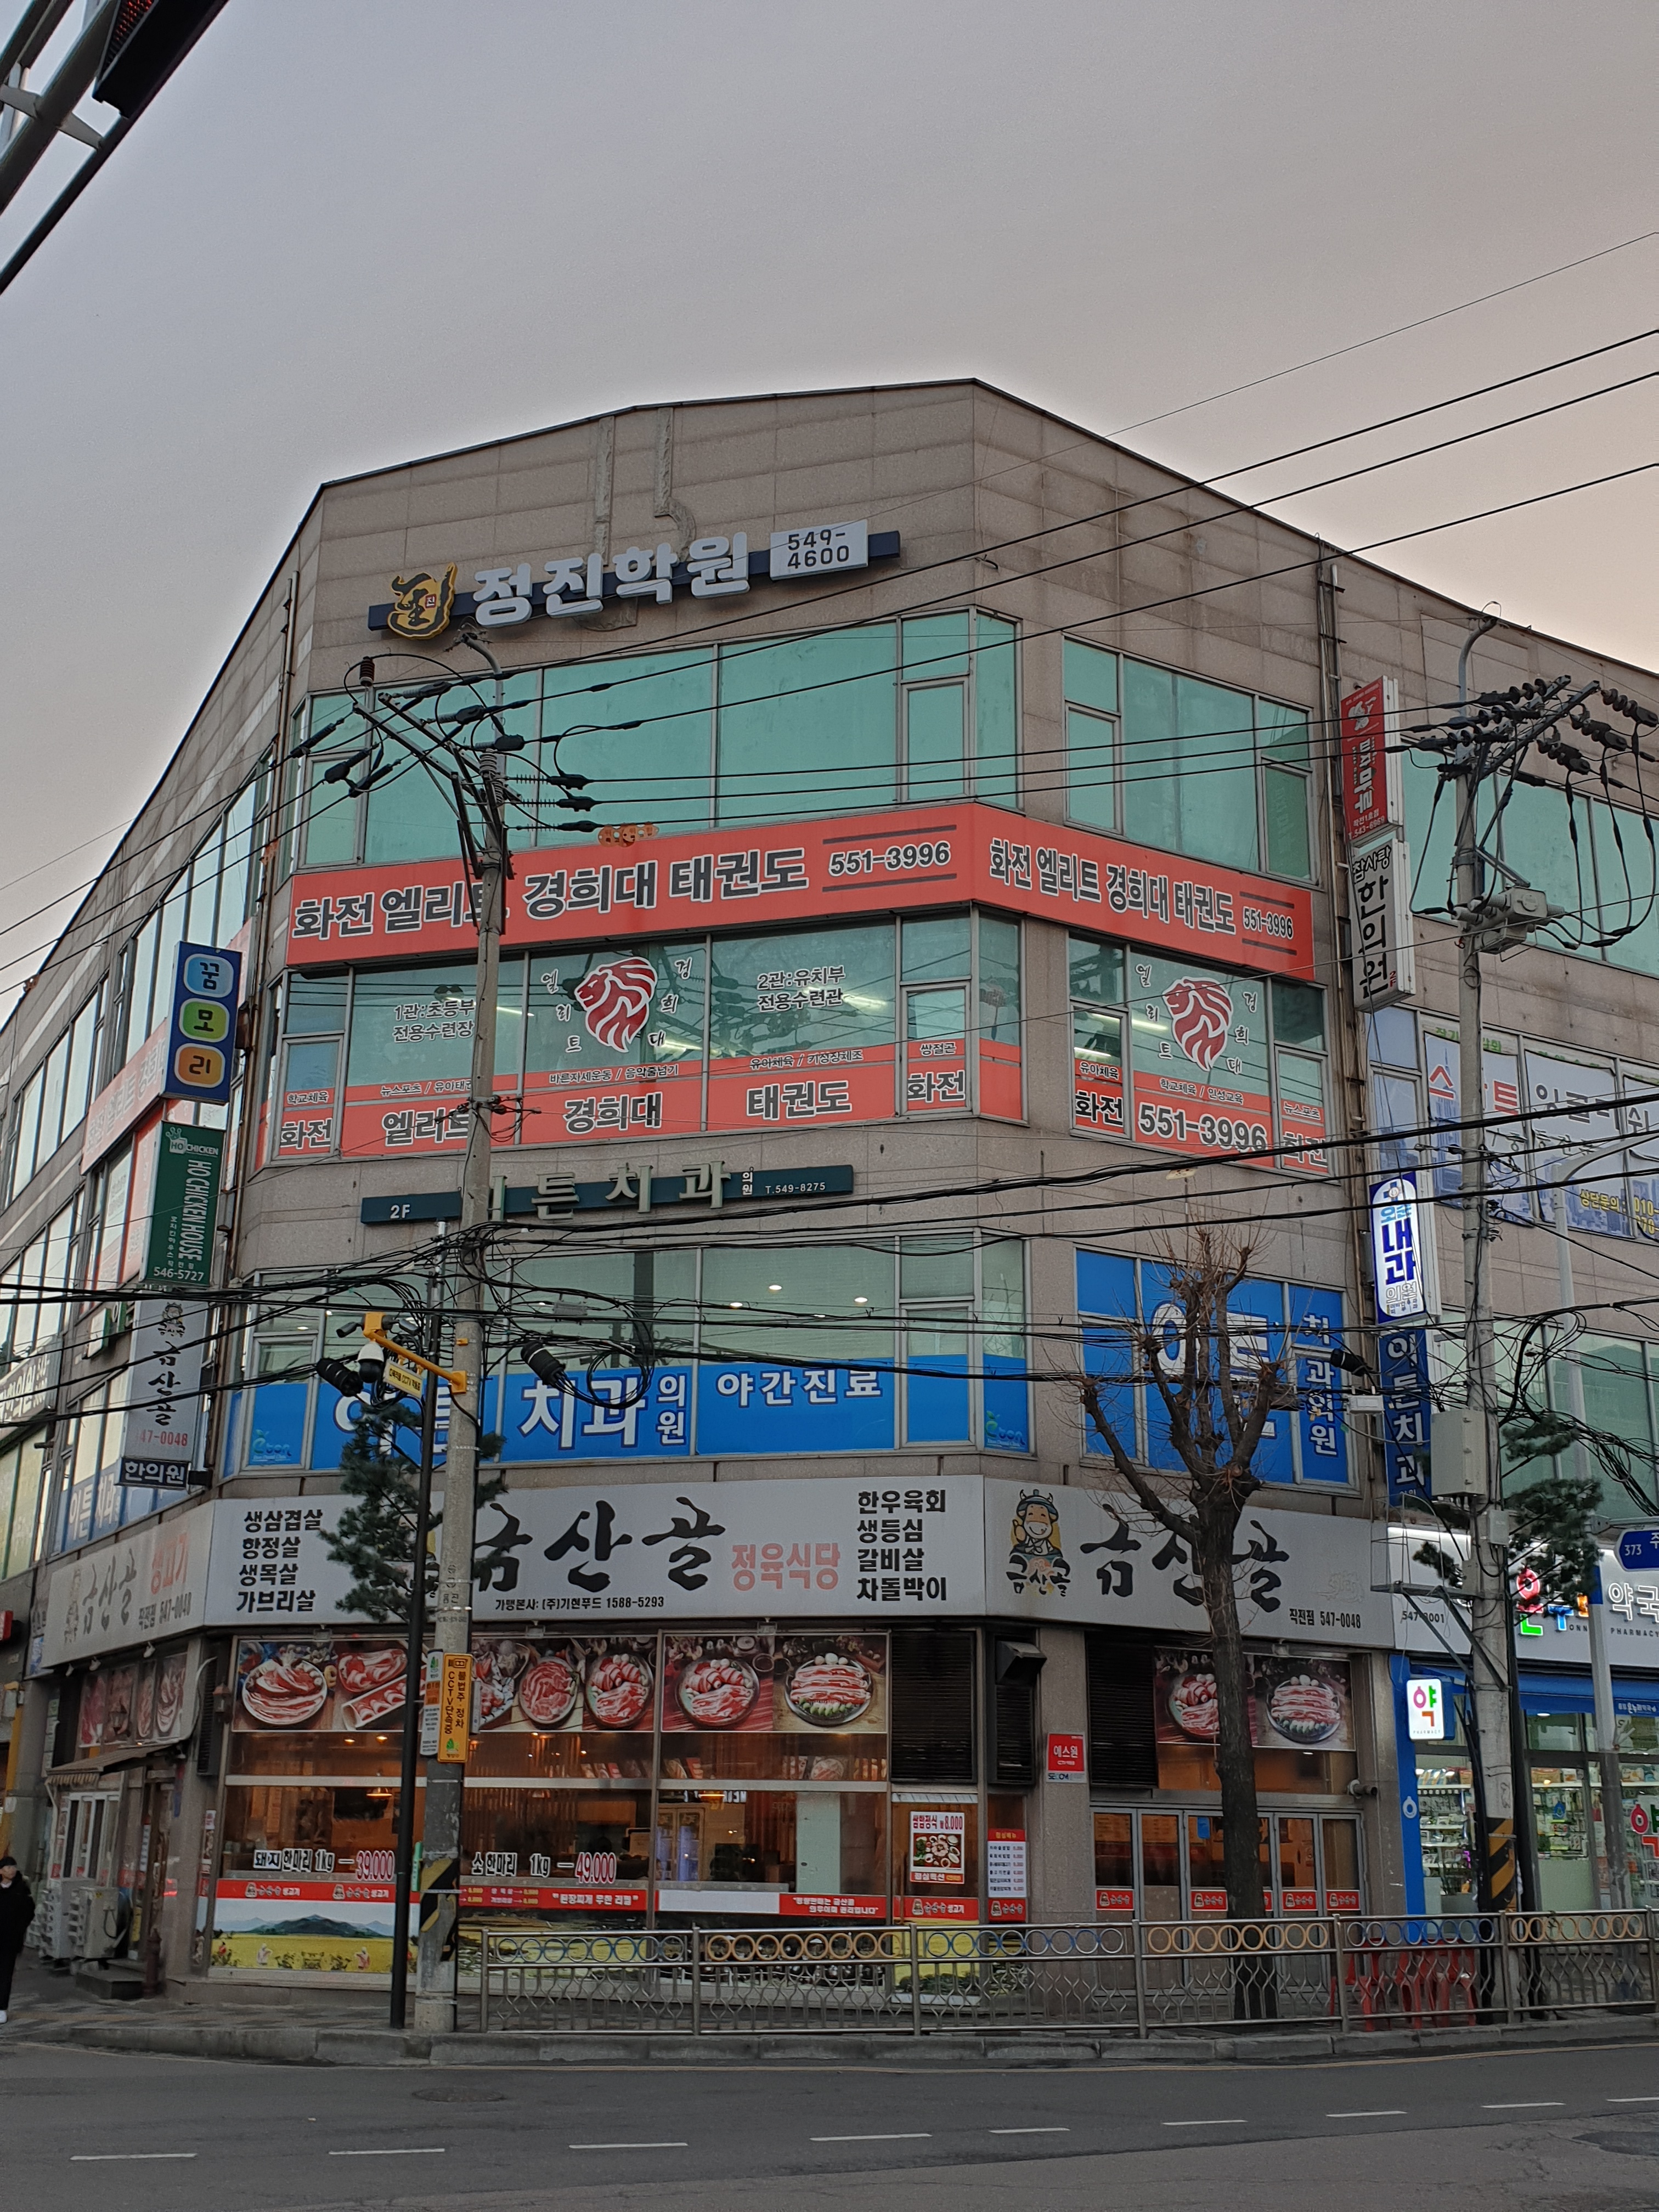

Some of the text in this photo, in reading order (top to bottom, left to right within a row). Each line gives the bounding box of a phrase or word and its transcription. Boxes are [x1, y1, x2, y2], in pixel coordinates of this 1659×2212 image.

[787, 529, 845, 551] 549-
[787, 544, 850, 569] 4600
[473, 531, 751, 628] 정진학원
[292, 891, 374, 940] 화전
[523, 860, 658, 921] 경희대
[669, 848, 809, 903] 태권도
[829, 840, 950, 877] 551-3996
[990, 837, 1294, 940] 화전 엘리트 경희대 태권도 551-3996
[1358, 875, 1389, 999] 한의원
[758, 988, 843, 1012] 전용수련관
[393, 1020, 475, 1042] 전용수련장
[920, 1042, 957, 1057] 쌍절곤
[550, 1064, 679, 1085] 바른자세운동 음악줄넘기
[749, 1056, 794, 1071] 유아체육
[1079, 1061, 1119, 1080] 유아체육
[287, 1091, 328, 1105] 학교체육
[380, 1082, 422, 1096] 뉴스포츠
[1160, 1078, 1244, 1105] 학교체육 인성교육
[1429, 1065, 1519, 1116] 스트
[279, 1118, 333, 1150] 화전
[563, 1091, 663, 1135] 경희대
[746, 1081, 852, 1121] 태권도
[907, 1070, 965, 1104] 화전
[1075, 1090, 1123, 1126] 화전
[1138, 1102, 1267, 1153] 551-3996
[171, 1141, 218, 1155] HO CHICKEN
[187, 1159, 212, 1177] HO
[765, 1182, 826, 1194] T.549-8275
[182, 1178, 210, 1223] CHICKEN
[390, 1204, 410, 1219] 2F
[178, 1223, 206, 1261] HOUSE
[1381, 1217, 1416, 1285] 내과
[154, 1267, 205, 1282] 546-5727
[1386, 1281, 1417, 1304] 의원
[146, 1341, 181, 1426] 금산골
[716, 1369, 882, 1407] 야간진료
[520, 1376, 646, 1448] 치과
[657, 1374, 686, 1446] 의원
[1387, 1333, 1424, 1486] 이든치과
[125, 1461, 185, 1485] 한의원
[69, 1472, 116, 1541] 이든 치과
[858, 1489, 946, 1514] 한우육회
[244, 1509, 323, 1532] 생삼겹살
[857, 1519, 923, 1543] 생등심
[242, 1536, 301, 1559] 항정살
[475, 1497, 726, 1592] 금산골
[1624, 1544, 1641, 1556] 373
[731, 1543, 840, 1591] 정육식당
[857, 1548, 924, 1572] 갈비살
[1080, 1503, 1290, 1612] 금산골
[239, 1564, 298, 1586] 생목살
[236, 1590, 315, 1612] 가브리살
[857, 1577, 946, 1601] 차돌박이
[607, 1596, 665, 1609] 1588-5293
[1609, 1583, 1659, 1624] 약국
[1290, 1609, 1361, 1628] 작전점 547-0048
[1413, 1685, 1437, 1727] 약
[315, 1849, 335, 1872] 1kg
[530, 1853, 551, 1878] 1kg
